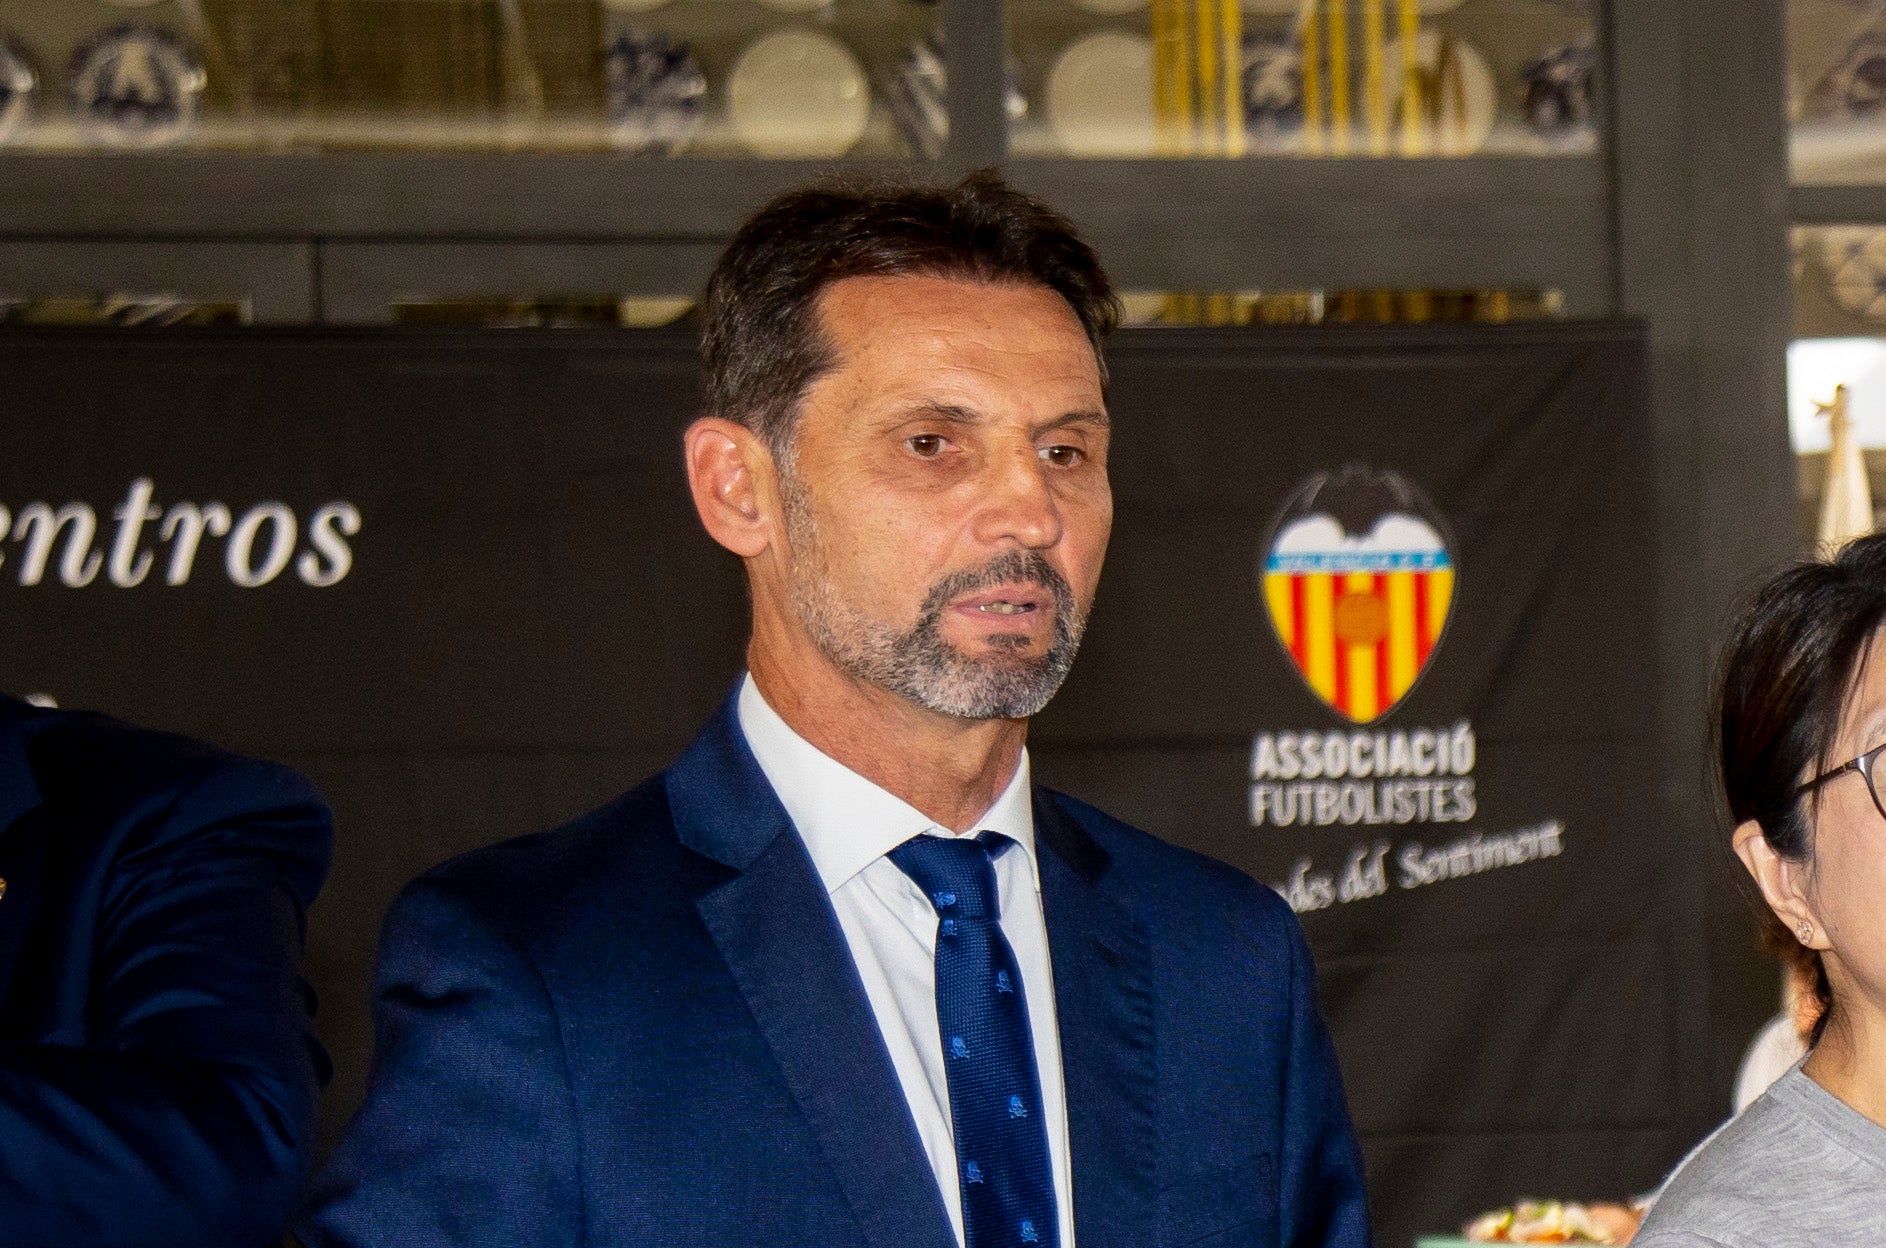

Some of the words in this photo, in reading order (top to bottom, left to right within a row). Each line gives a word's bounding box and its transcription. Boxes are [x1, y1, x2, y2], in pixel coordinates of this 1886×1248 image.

[0, 474, 363, 589] ntros
[1252, 721, 1476, 779] ASSOCIACIÓ
[1250, 779, 1477, 826] FUTBOLISTES
[1399, 819, 1565, 889] Sentiment
